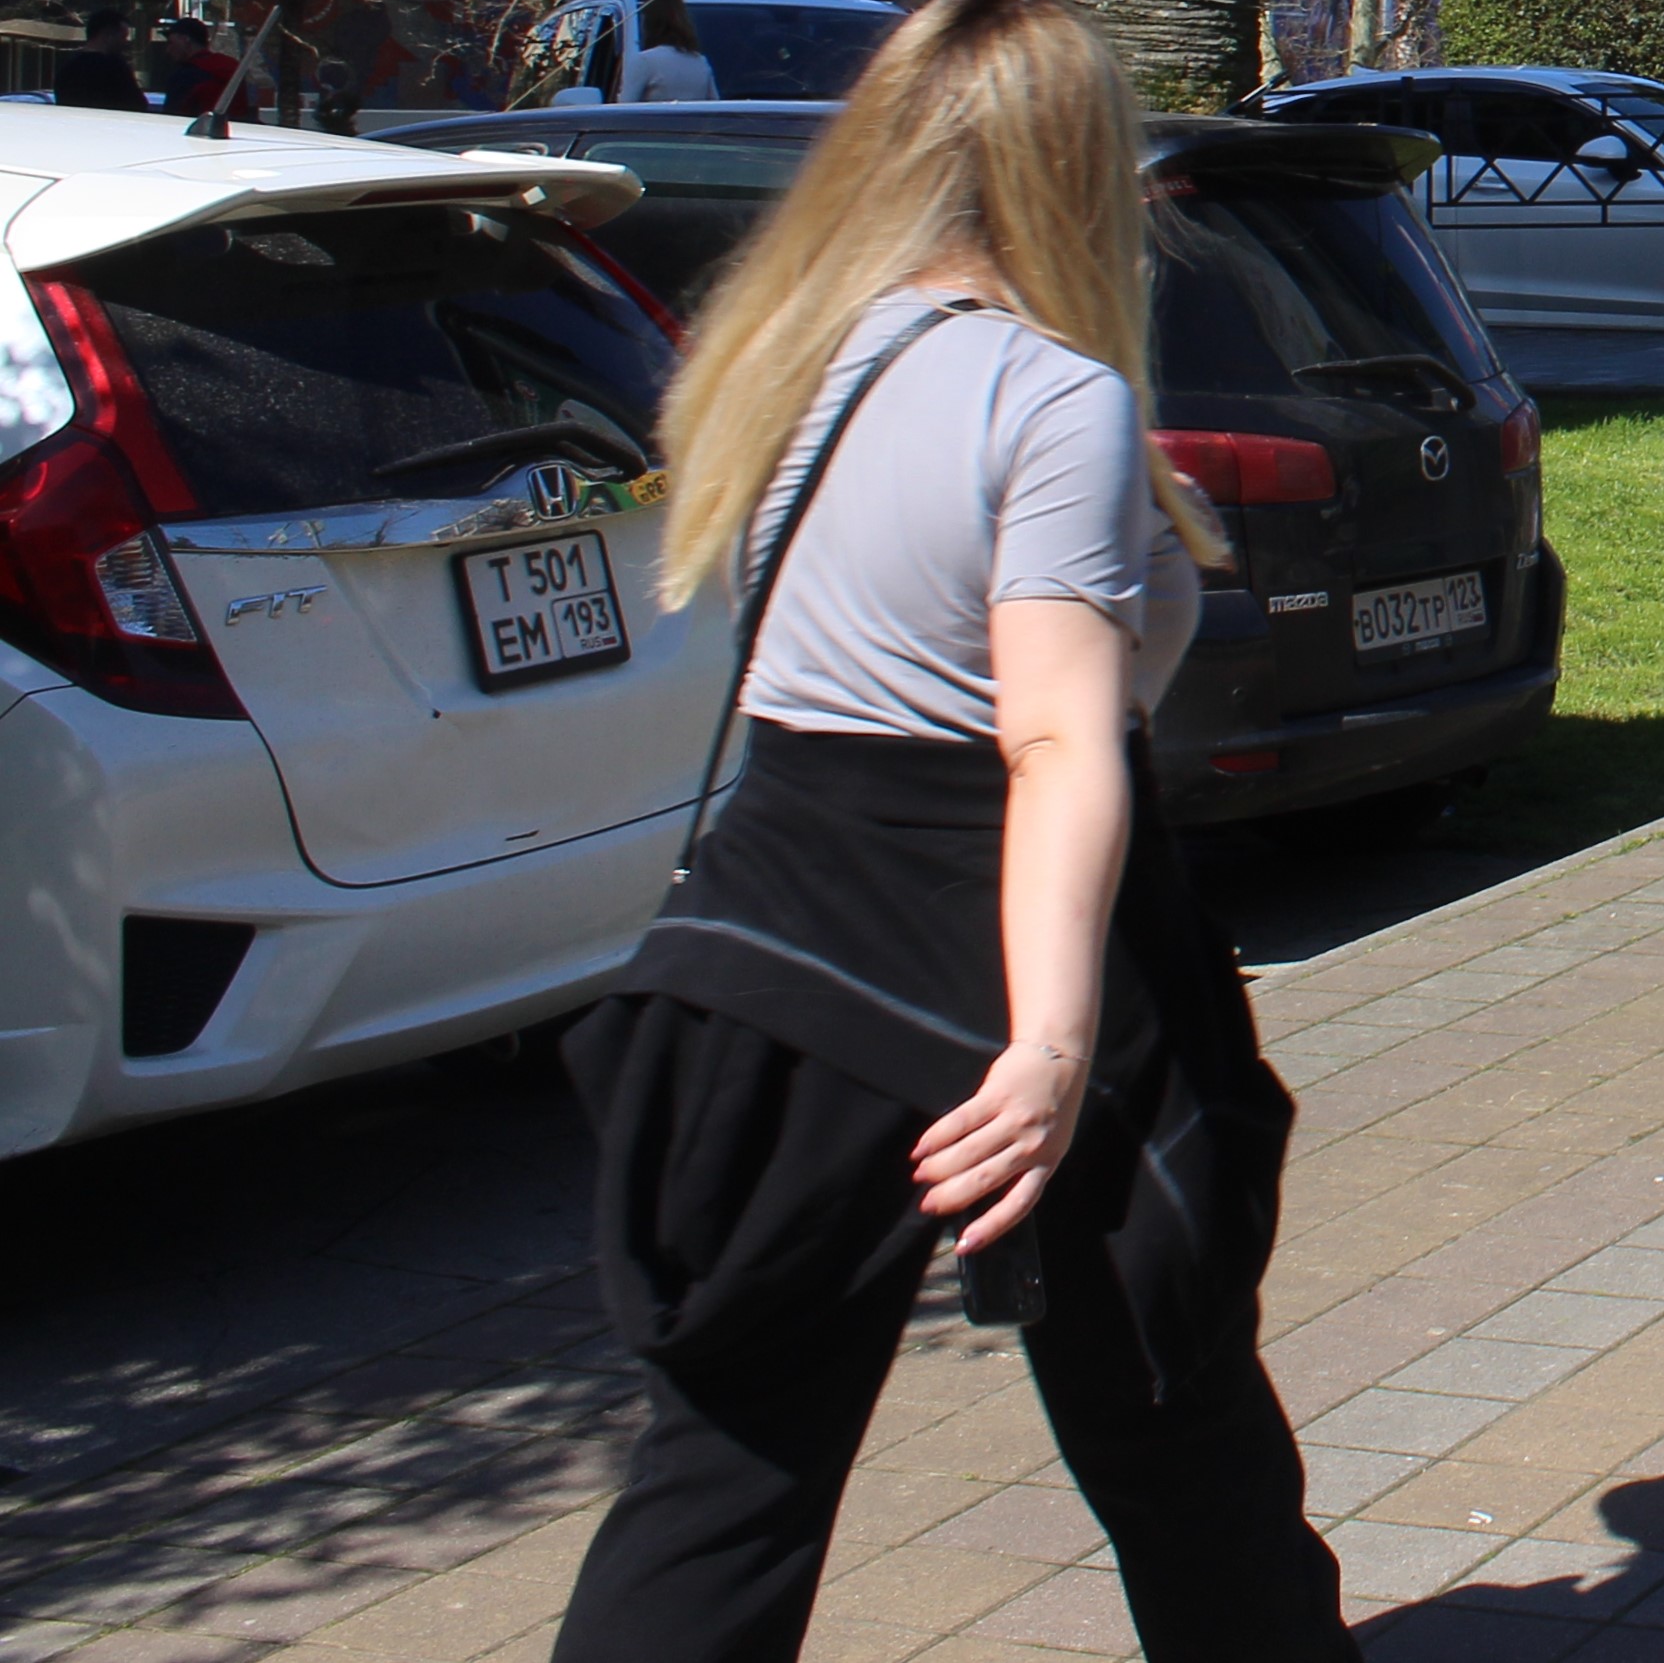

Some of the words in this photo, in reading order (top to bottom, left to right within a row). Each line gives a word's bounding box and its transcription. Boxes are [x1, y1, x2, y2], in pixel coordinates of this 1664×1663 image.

[524, 543, 588, 596] 501
[225, 583, 329, 627] FIT
[1448, 576, 1482, 611] 123
[562, 597, 611, 638] 193
